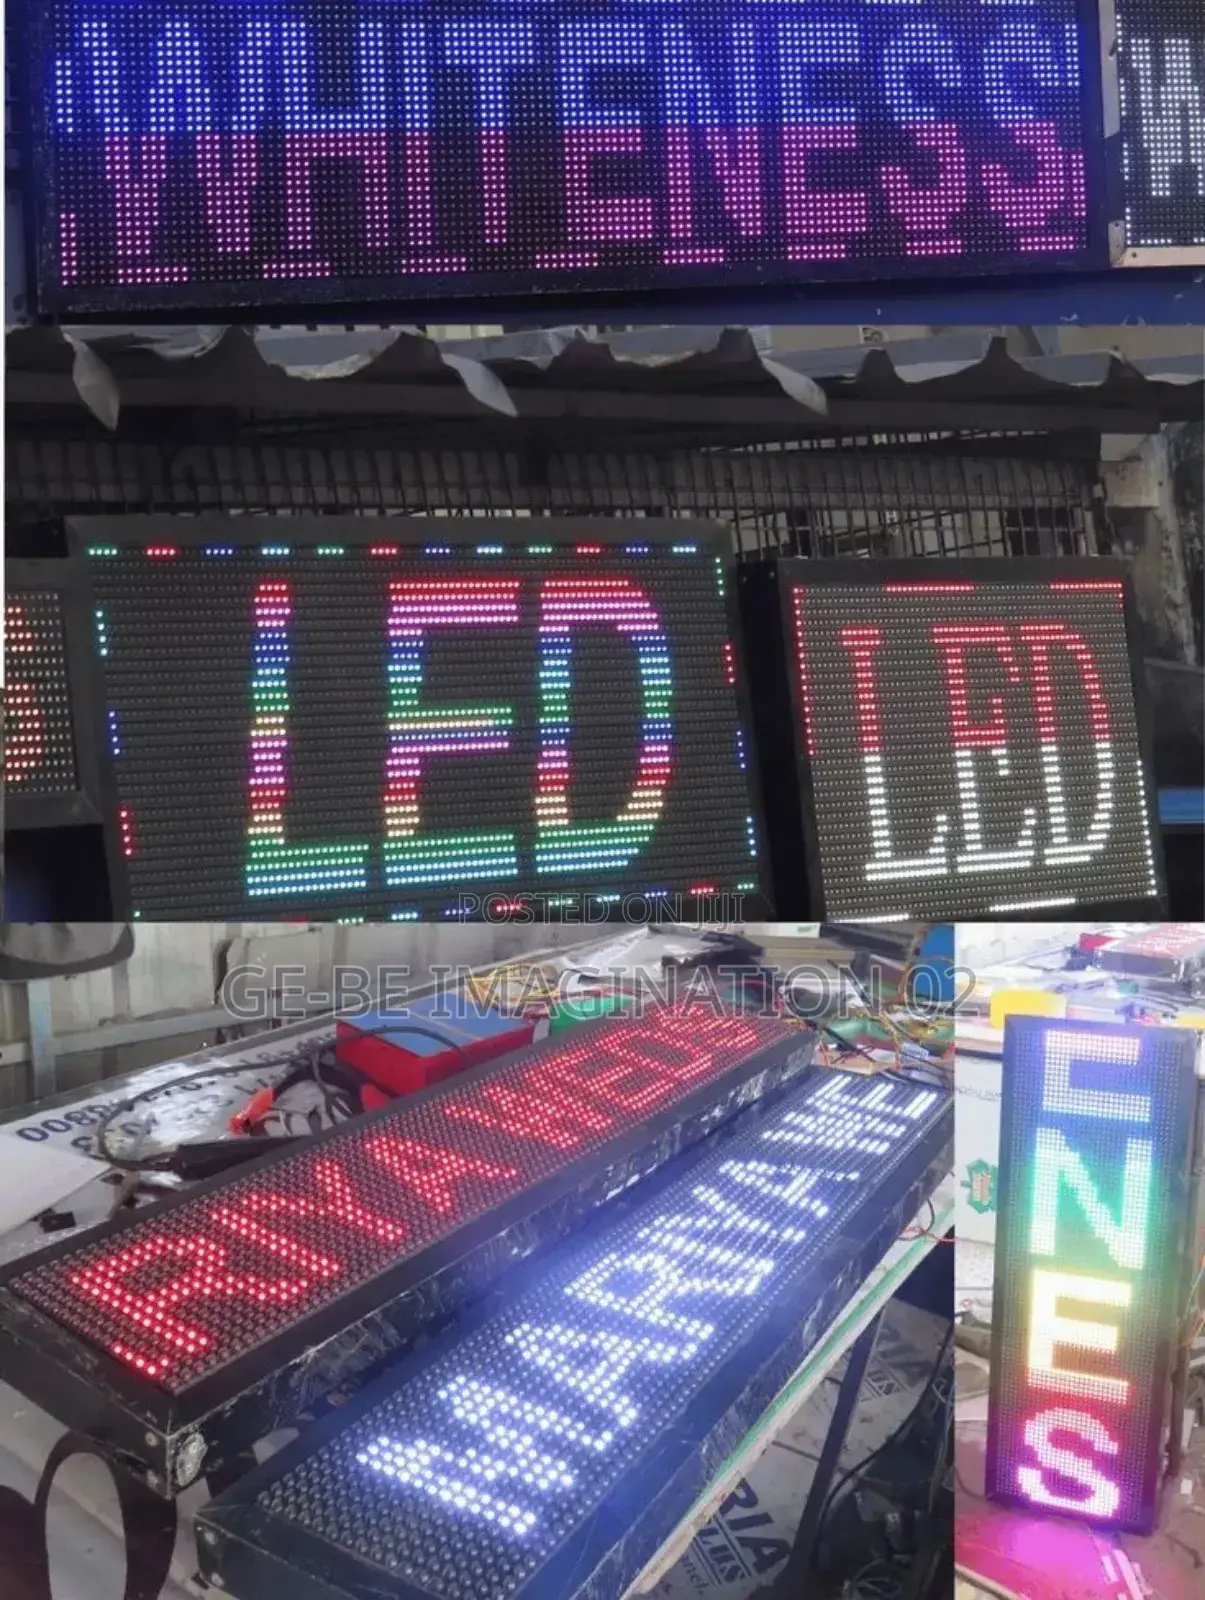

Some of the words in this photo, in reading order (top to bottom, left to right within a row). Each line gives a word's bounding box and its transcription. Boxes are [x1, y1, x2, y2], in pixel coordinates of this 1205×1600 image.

[244, 580, 674, 897] LED
[840, 623, 1115, 882] LED
[66, 1134, 518, 1375] RIYA
